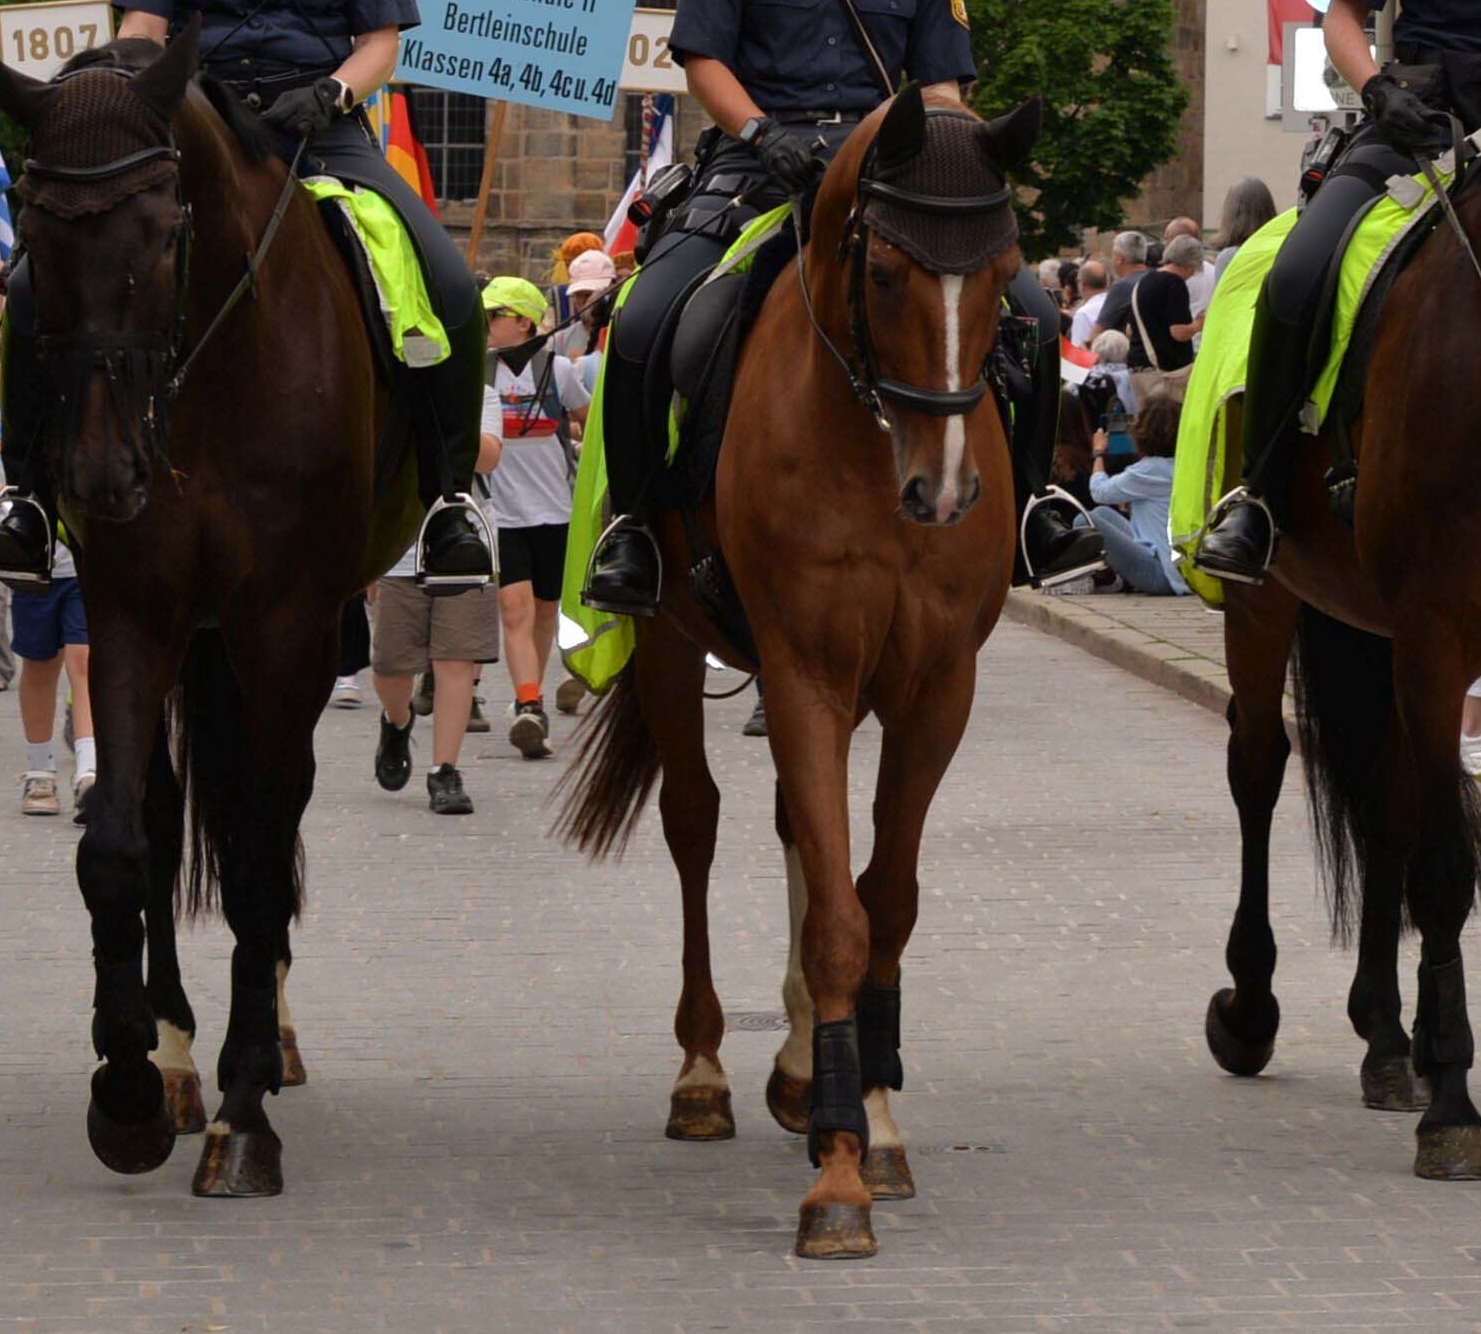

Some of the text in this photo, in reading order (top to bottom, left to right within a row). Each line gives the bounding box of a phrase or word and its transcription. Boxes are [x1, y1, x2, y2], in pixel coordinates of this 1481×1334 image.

[13, 24, 97, 62] 1807
[443, 2, 588, 56] Bertleinschule
[402, 39, 483, 81] Klassen
